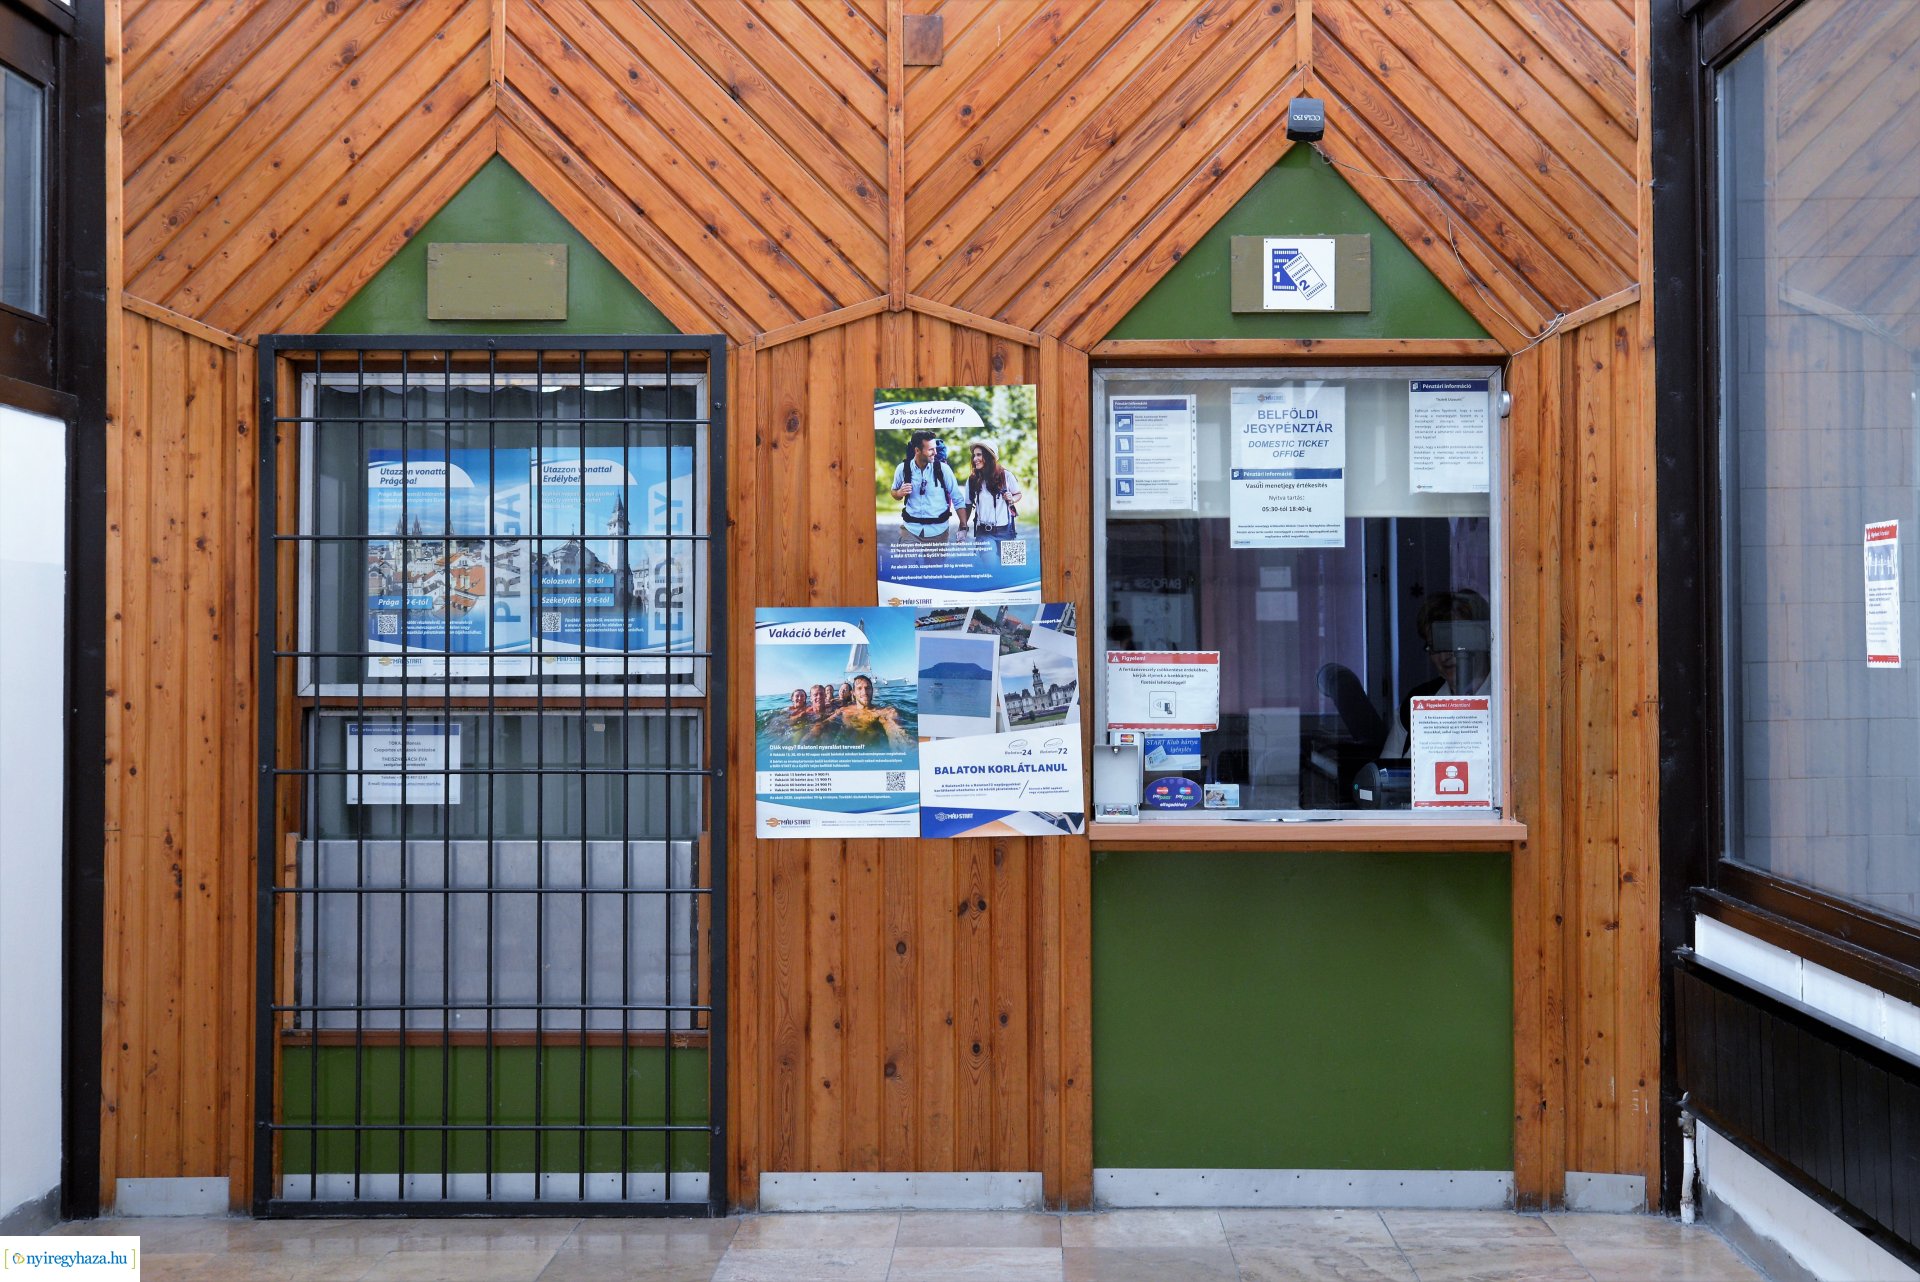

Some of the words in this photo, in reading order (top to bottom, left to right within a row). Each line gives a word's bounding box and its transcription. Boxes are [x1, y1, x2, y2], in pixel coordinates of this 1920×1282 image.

[1274, 272, 1280, 282] 1
[1299, 280, 1310, 291] 2
[890, 408, 918, 416] 33%-os
[919, 407, 965, 416] kedvezmény
[1258, 407, 1318, 419] BELFÖLDI
[890, 416, 922, 426] dolgozói
[924, 416, 954, 424] bérlettel
[1244, 422, 1333, 434] JEGYPÉNZTÁR
[1248, 440, 1294, 448] DOMESTIC
[1298, 440, 1329, 448] TICKET
[1272, 450, 1305, 458] OFFICE
[380, 468, 414, 476] Utazzn
[378, 598, 400, 606] Prága
[769, 628, 811, 638] Vakáció
[814, 628, 846, 638] bérlet
[934, 766, 986, 775] BALATON
[988, 762, 1068, 774] KORLÁTLANUL
